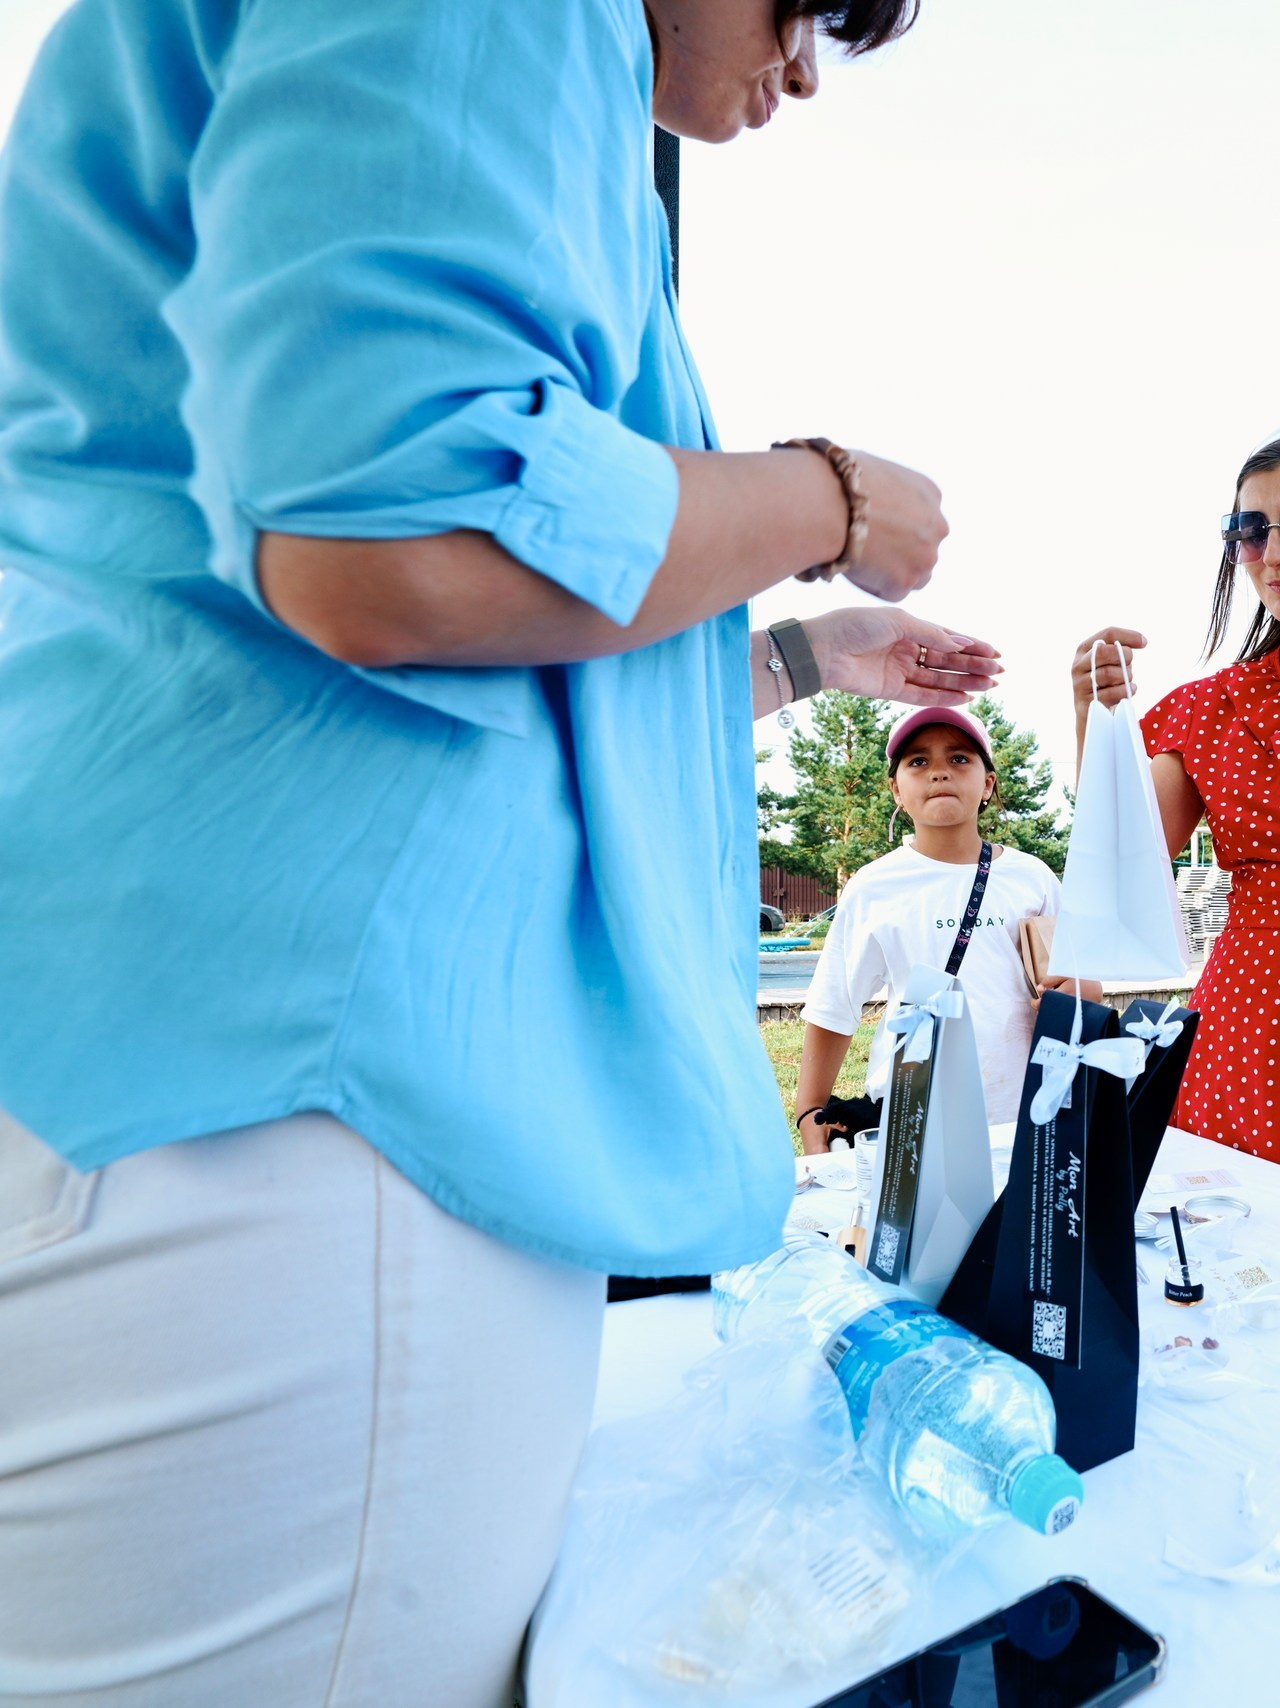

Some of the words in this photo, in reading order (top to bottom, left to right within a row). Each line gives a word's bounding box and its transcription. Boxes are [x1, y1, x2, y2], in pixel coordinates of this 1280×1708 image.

[915, 1101, 924, 1134] Mon
[910, 1141, 919, 1175] Art
[1068, 1151, 1081, 1190] Mon
[1056, 1170, 1068, 1181] by
[1055, 1186, 1068, 1211] Polly
[1067, 1198, 1081, 1237] Art
